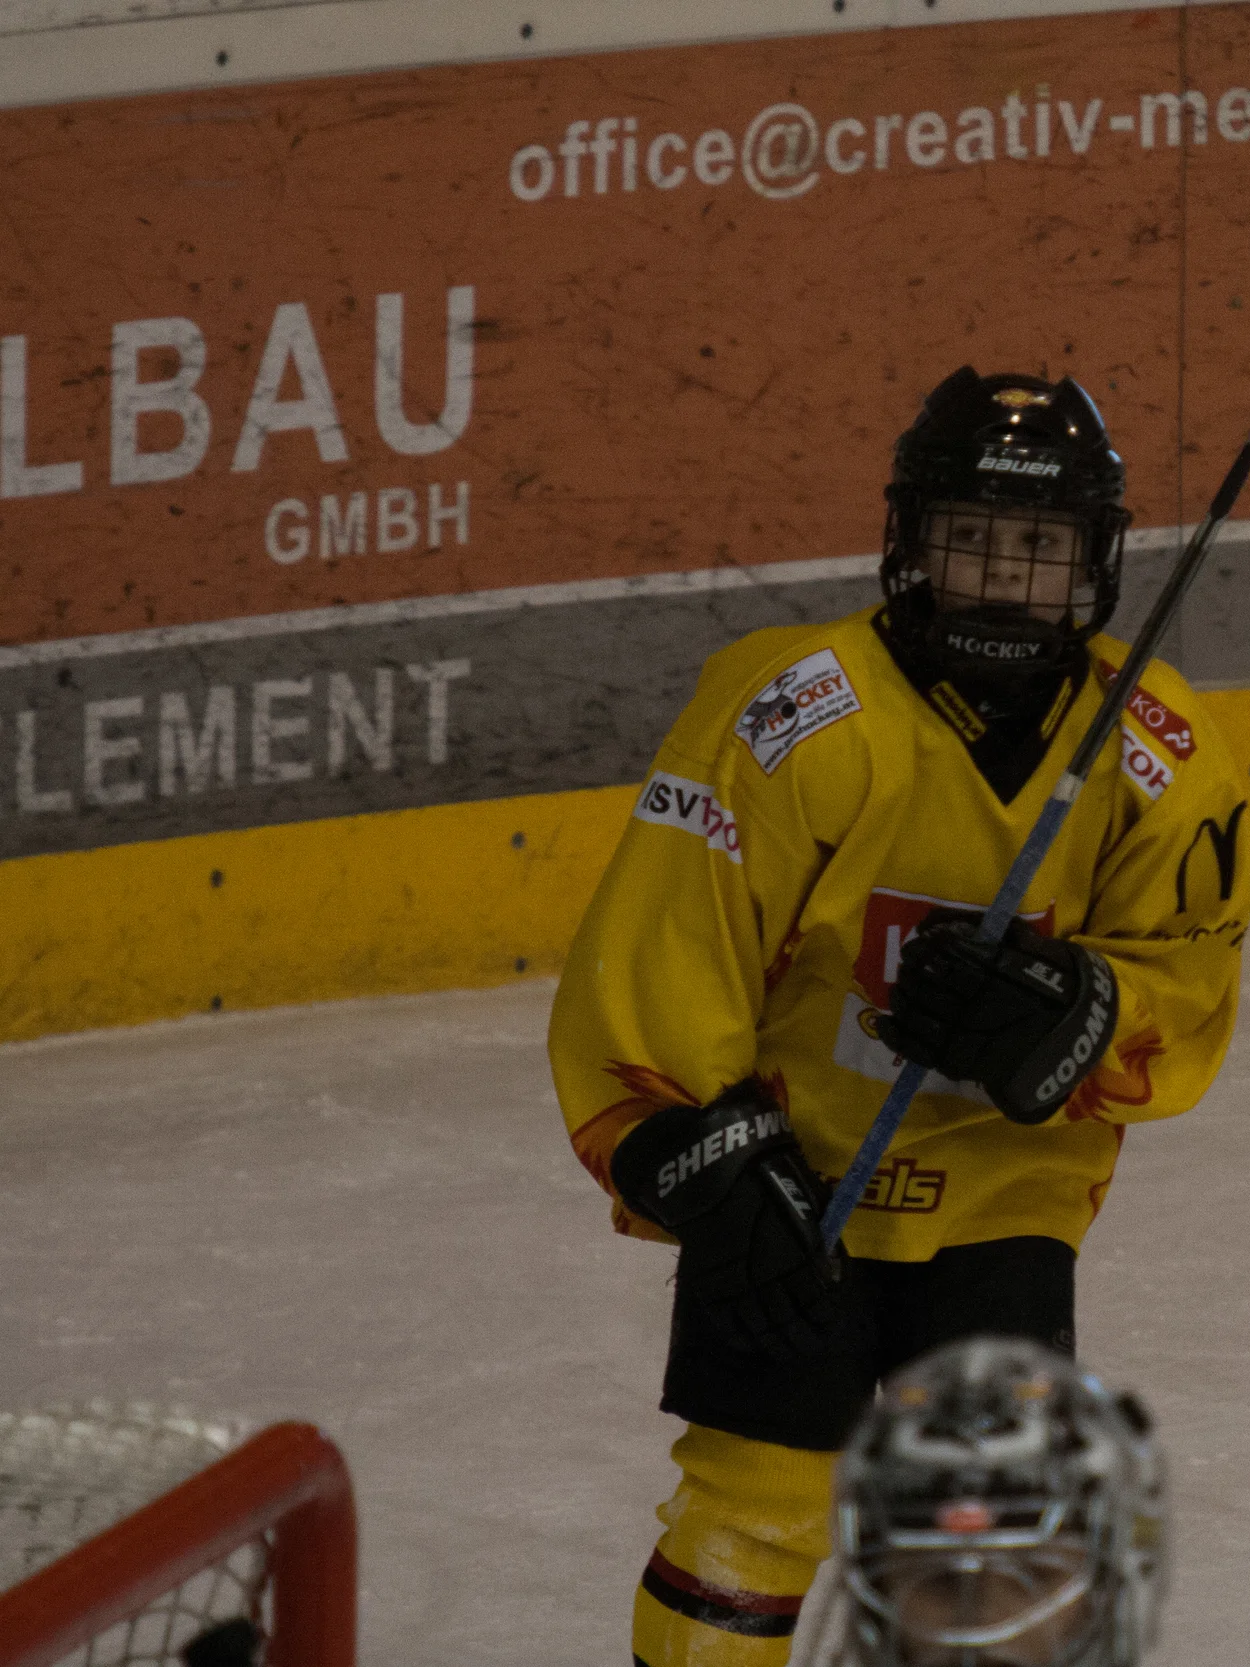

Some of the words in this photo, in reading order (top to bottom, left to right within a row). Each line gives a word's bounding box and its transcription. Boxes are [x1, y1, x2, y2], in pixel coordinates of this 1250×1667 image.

[0, 285, 476, 499] LBAU
[264, 481, 470, 565] GMBH
[947, 633, 1041, 659] HOCKEY
[15, 657, 472, 813] LEMENT
